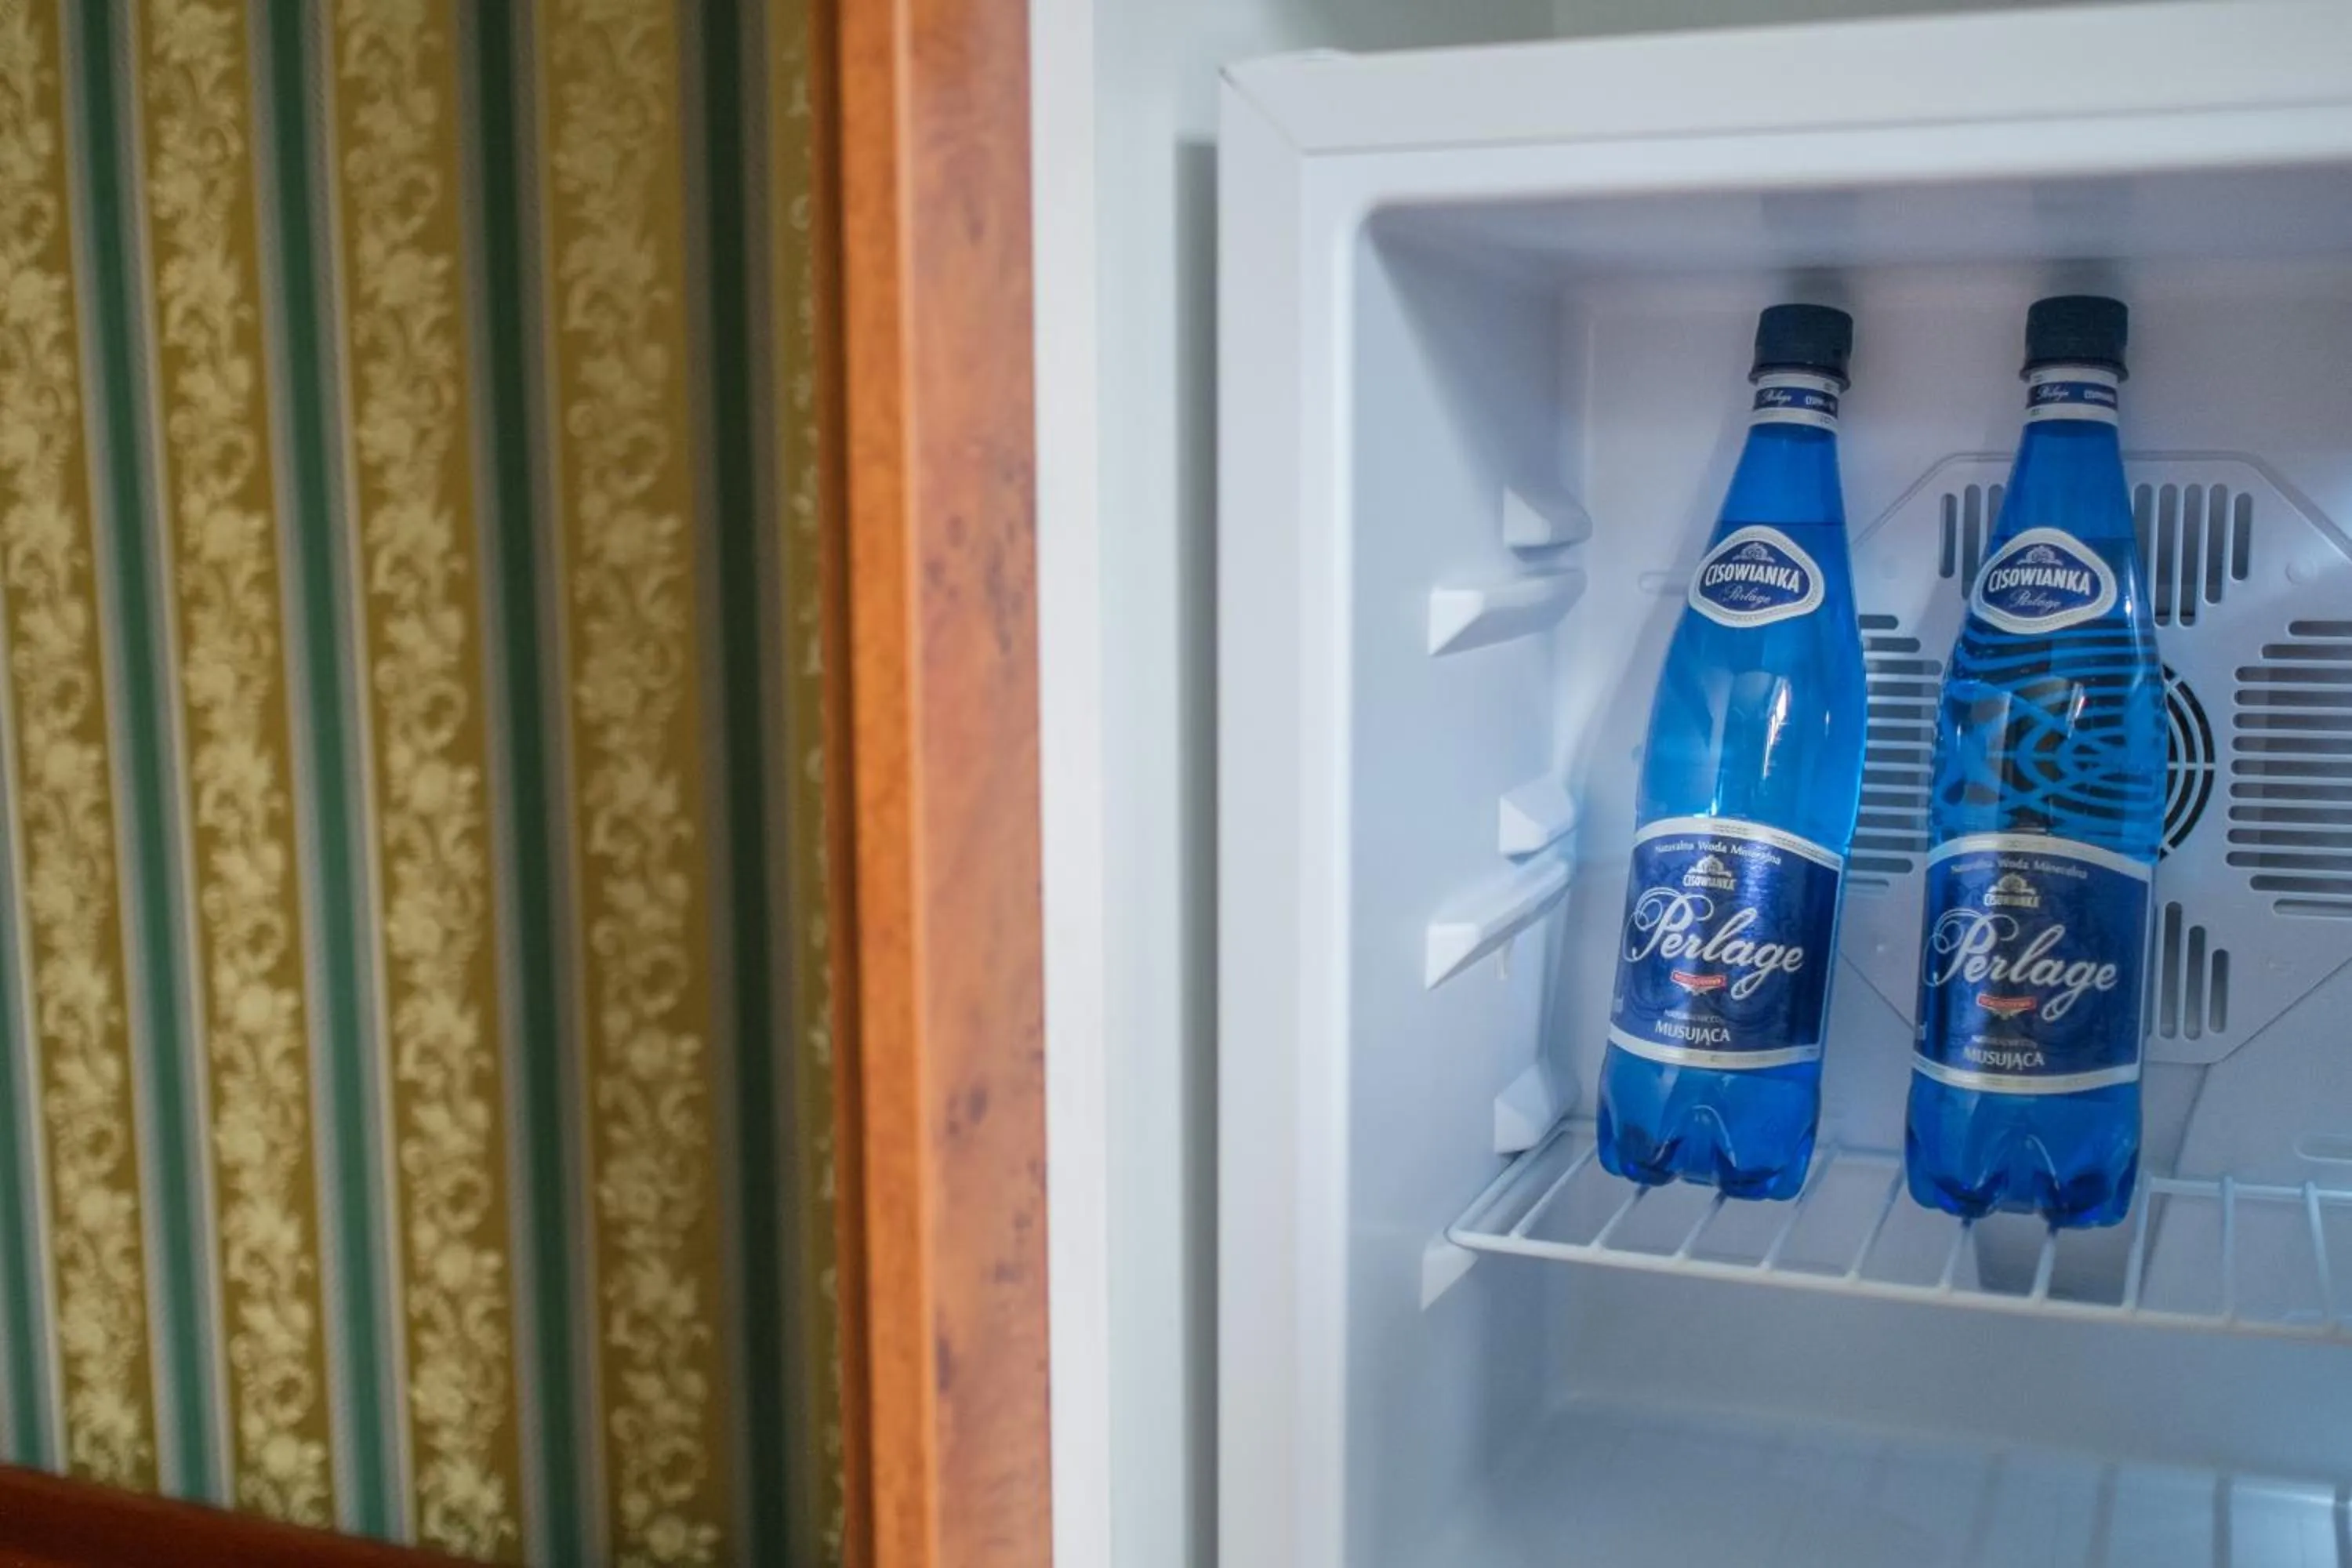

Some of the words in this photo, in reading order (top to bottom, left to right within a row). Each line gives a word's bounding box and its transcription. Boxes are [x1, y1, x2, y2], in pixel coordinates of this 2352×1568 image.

[1705, 564, 1800, 593] CISOWIANKA
[1987, 567, 2090, 596] CISOWIANKA
[1698, 840, 1727, 854] Woda
[1730, 844, 1781, 866] Mineralna
[1623, 887, 1804, 1000] Perlage
[1923, 909, 2118, 1021] Perlage
[1654, 1020, 1731, 1046] MUSUJĄCA
[1963, 1047, 2045, 1071] MUSUJĄCA
